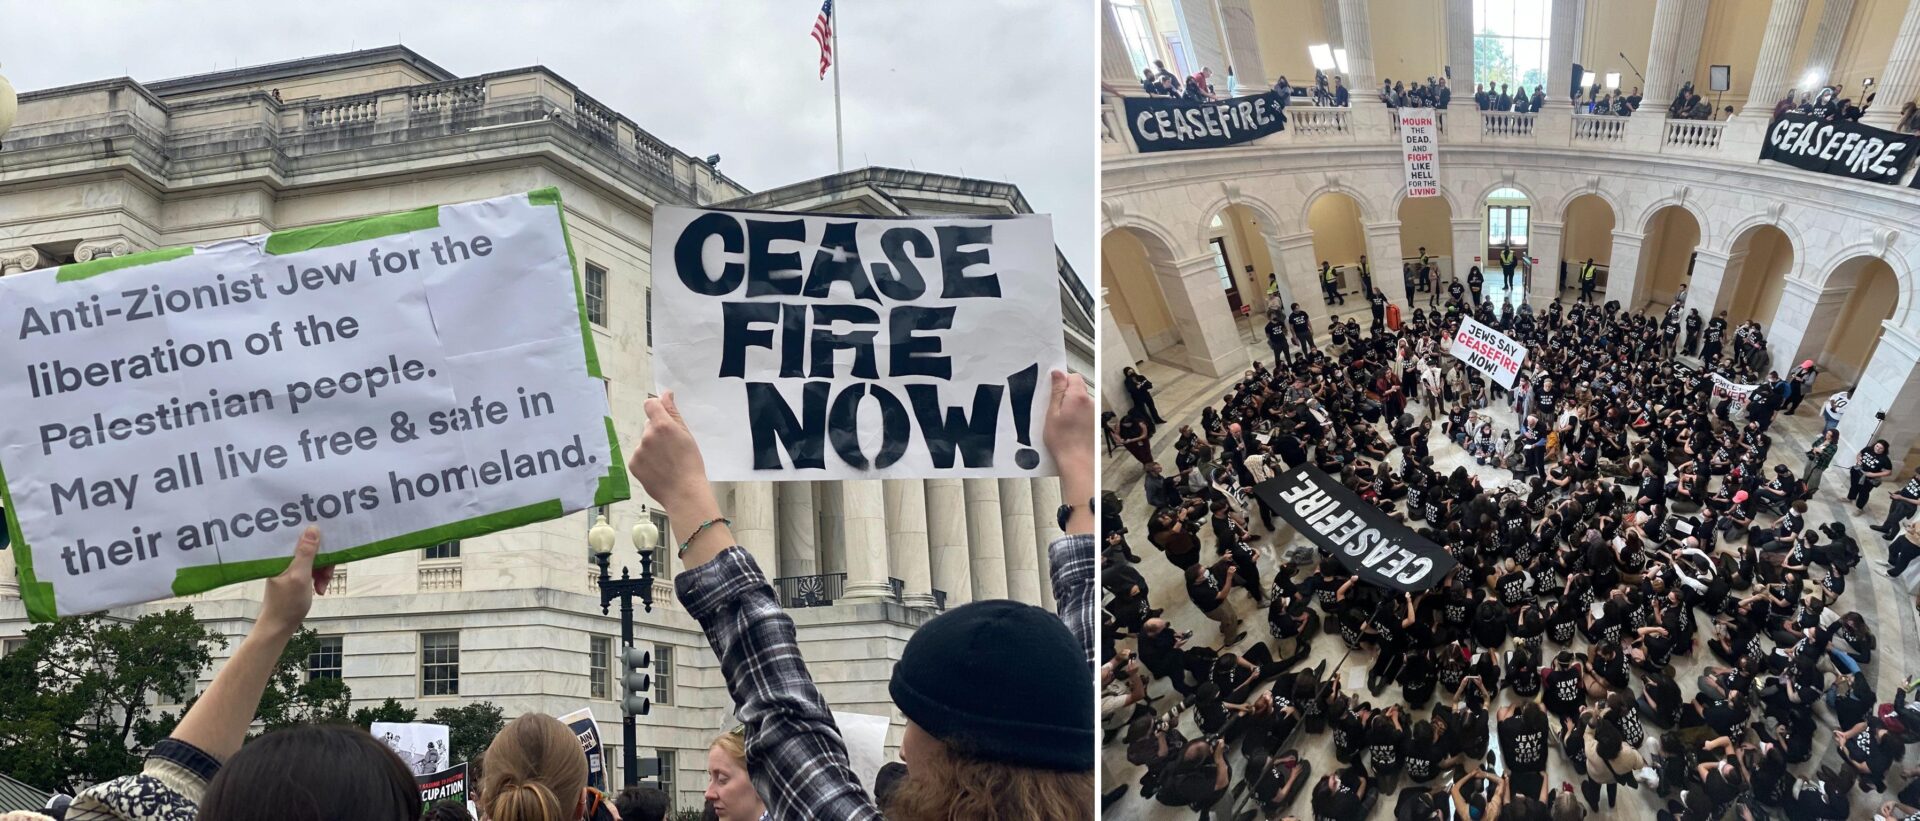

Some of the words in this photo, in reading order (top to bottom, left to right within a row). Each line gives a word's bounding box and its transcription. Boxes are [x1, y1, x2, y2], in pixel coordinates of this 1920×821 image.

[1136, 98, 1275, 141] CEASEFIRE.
[1402, 118, 1432, 126] MOURN
[1407, 153, 1433, 161] FIGHT
[1770, 119, 1906, 176] CEASEFIRE.
[1409, 188, 1436, 196] LIVING
[1411, 171, 1433, 179] HELL
[674, 212, 1002, 306] CEASE
[18, 273, 267, 341] Anti-Zionist
[276, 259, 357, 296] Jew
[367, 246, 421, 277] for
[430, 232, 494, 266] the
[27, 338, 233, 399] liberation
[244, 321, 283, 356] of
[293, 313, 359, 347] the
[718, 301, 957, 381] FIRE
[1458, 332, 1519, 375] CEASEFIRE
[1469, 324, 1497, 346] JEWS
[1497, 339, 1518, 357] SAY
[1467, 352, 1498, 376] NOW!
[39, 388, 275, 456] Palestinian
[286, 354, 437, 415] people.
[745, 362, 1040, 471] NOW!
[50, 473, 139, 516] May
[153, 451, 204, 494] all
[213, 443, 288, 481] live
[297, 425, 379, 463] free
[390, 410, 420, 444] &
[428, 395, 509, 436] safe
[519, 387, 555, 421] in
[60, 525, 163, 577] their
[175, 485, 380, 552] ancestors
[388, 434, 597, 505] homeland.
[1279, 471, 1433, 585] CEASEFIRE.
[1556, 677, 1578, 688] JEWS
[1515, 731, 1543, 742] JEWS
[1518, 739, 1538, 749] SAY
[421, 779, 464, 802] CUPATION
